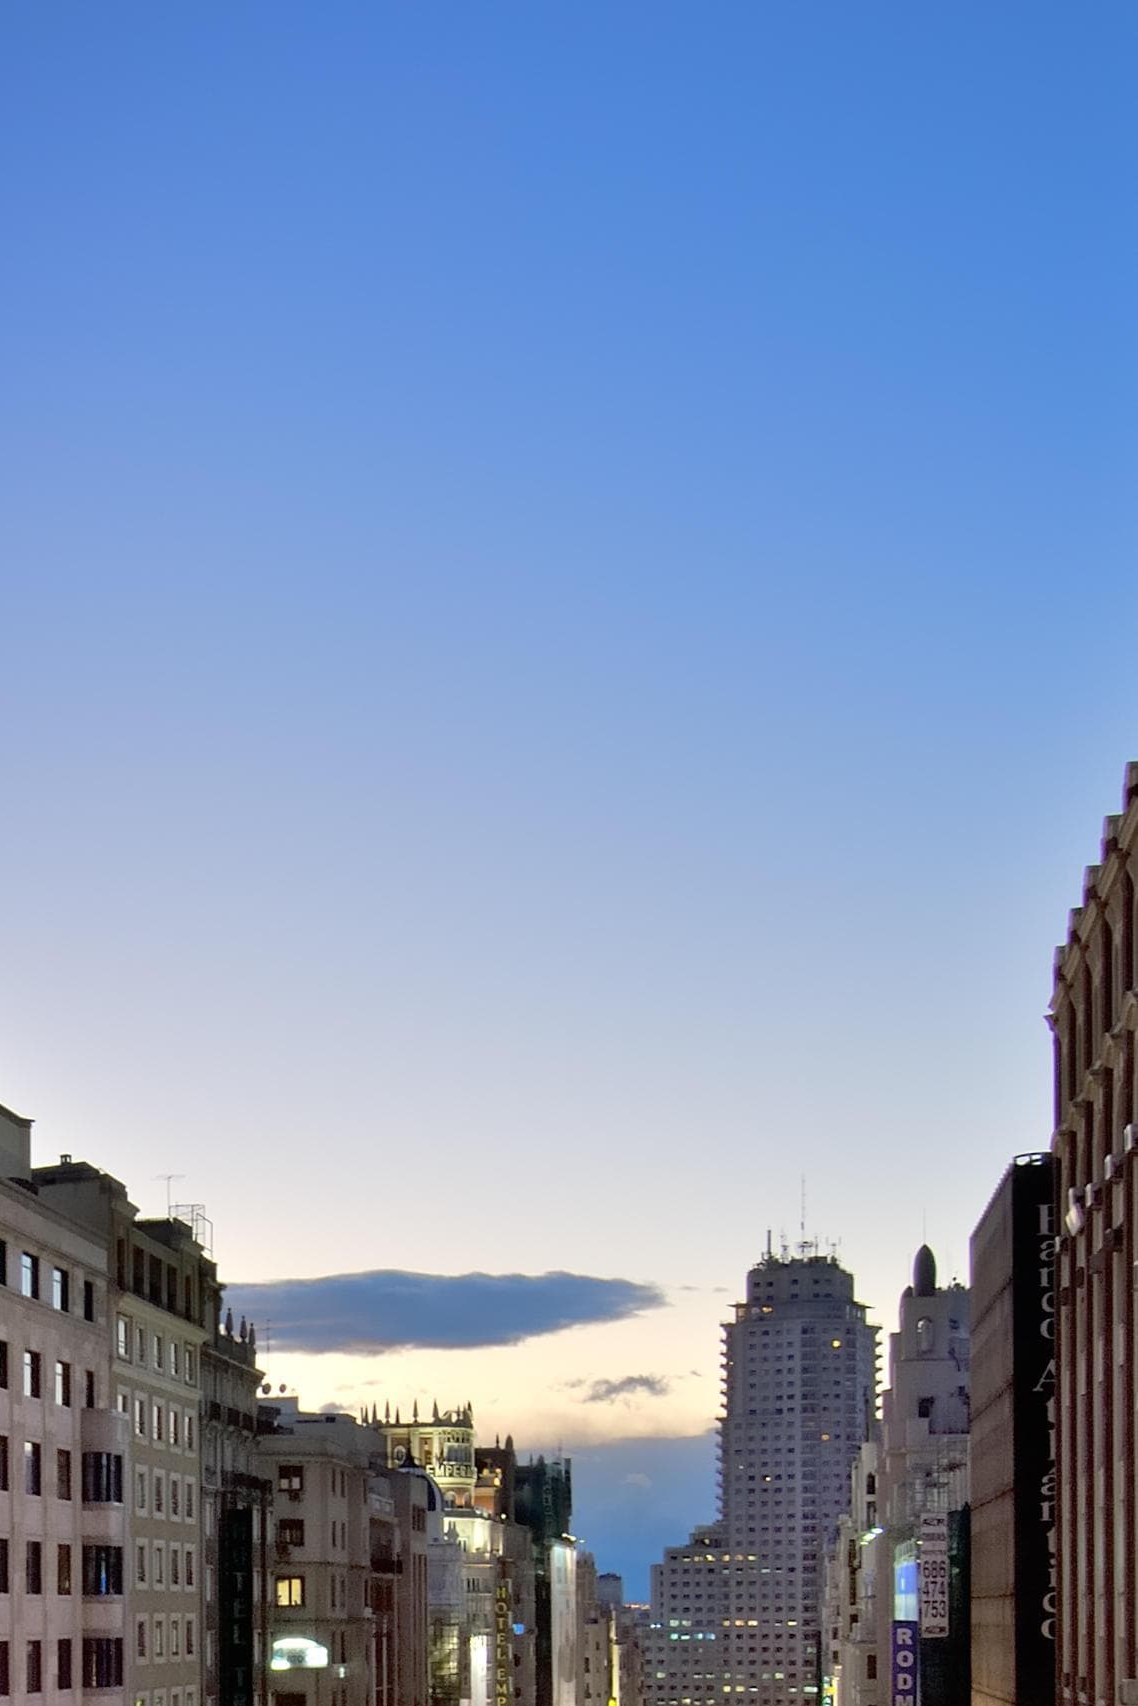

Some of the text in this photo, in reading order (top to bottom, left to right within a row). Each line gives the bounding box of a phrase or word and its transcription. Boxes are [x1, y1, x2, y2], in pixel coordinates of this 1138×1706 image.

[922, 1560, 946, 1579] 686
[922, 1581, 946, 1598] 474
[922, 1600, 946, 1618] 753
[495, 1586, 508, 1660] HOTEL
